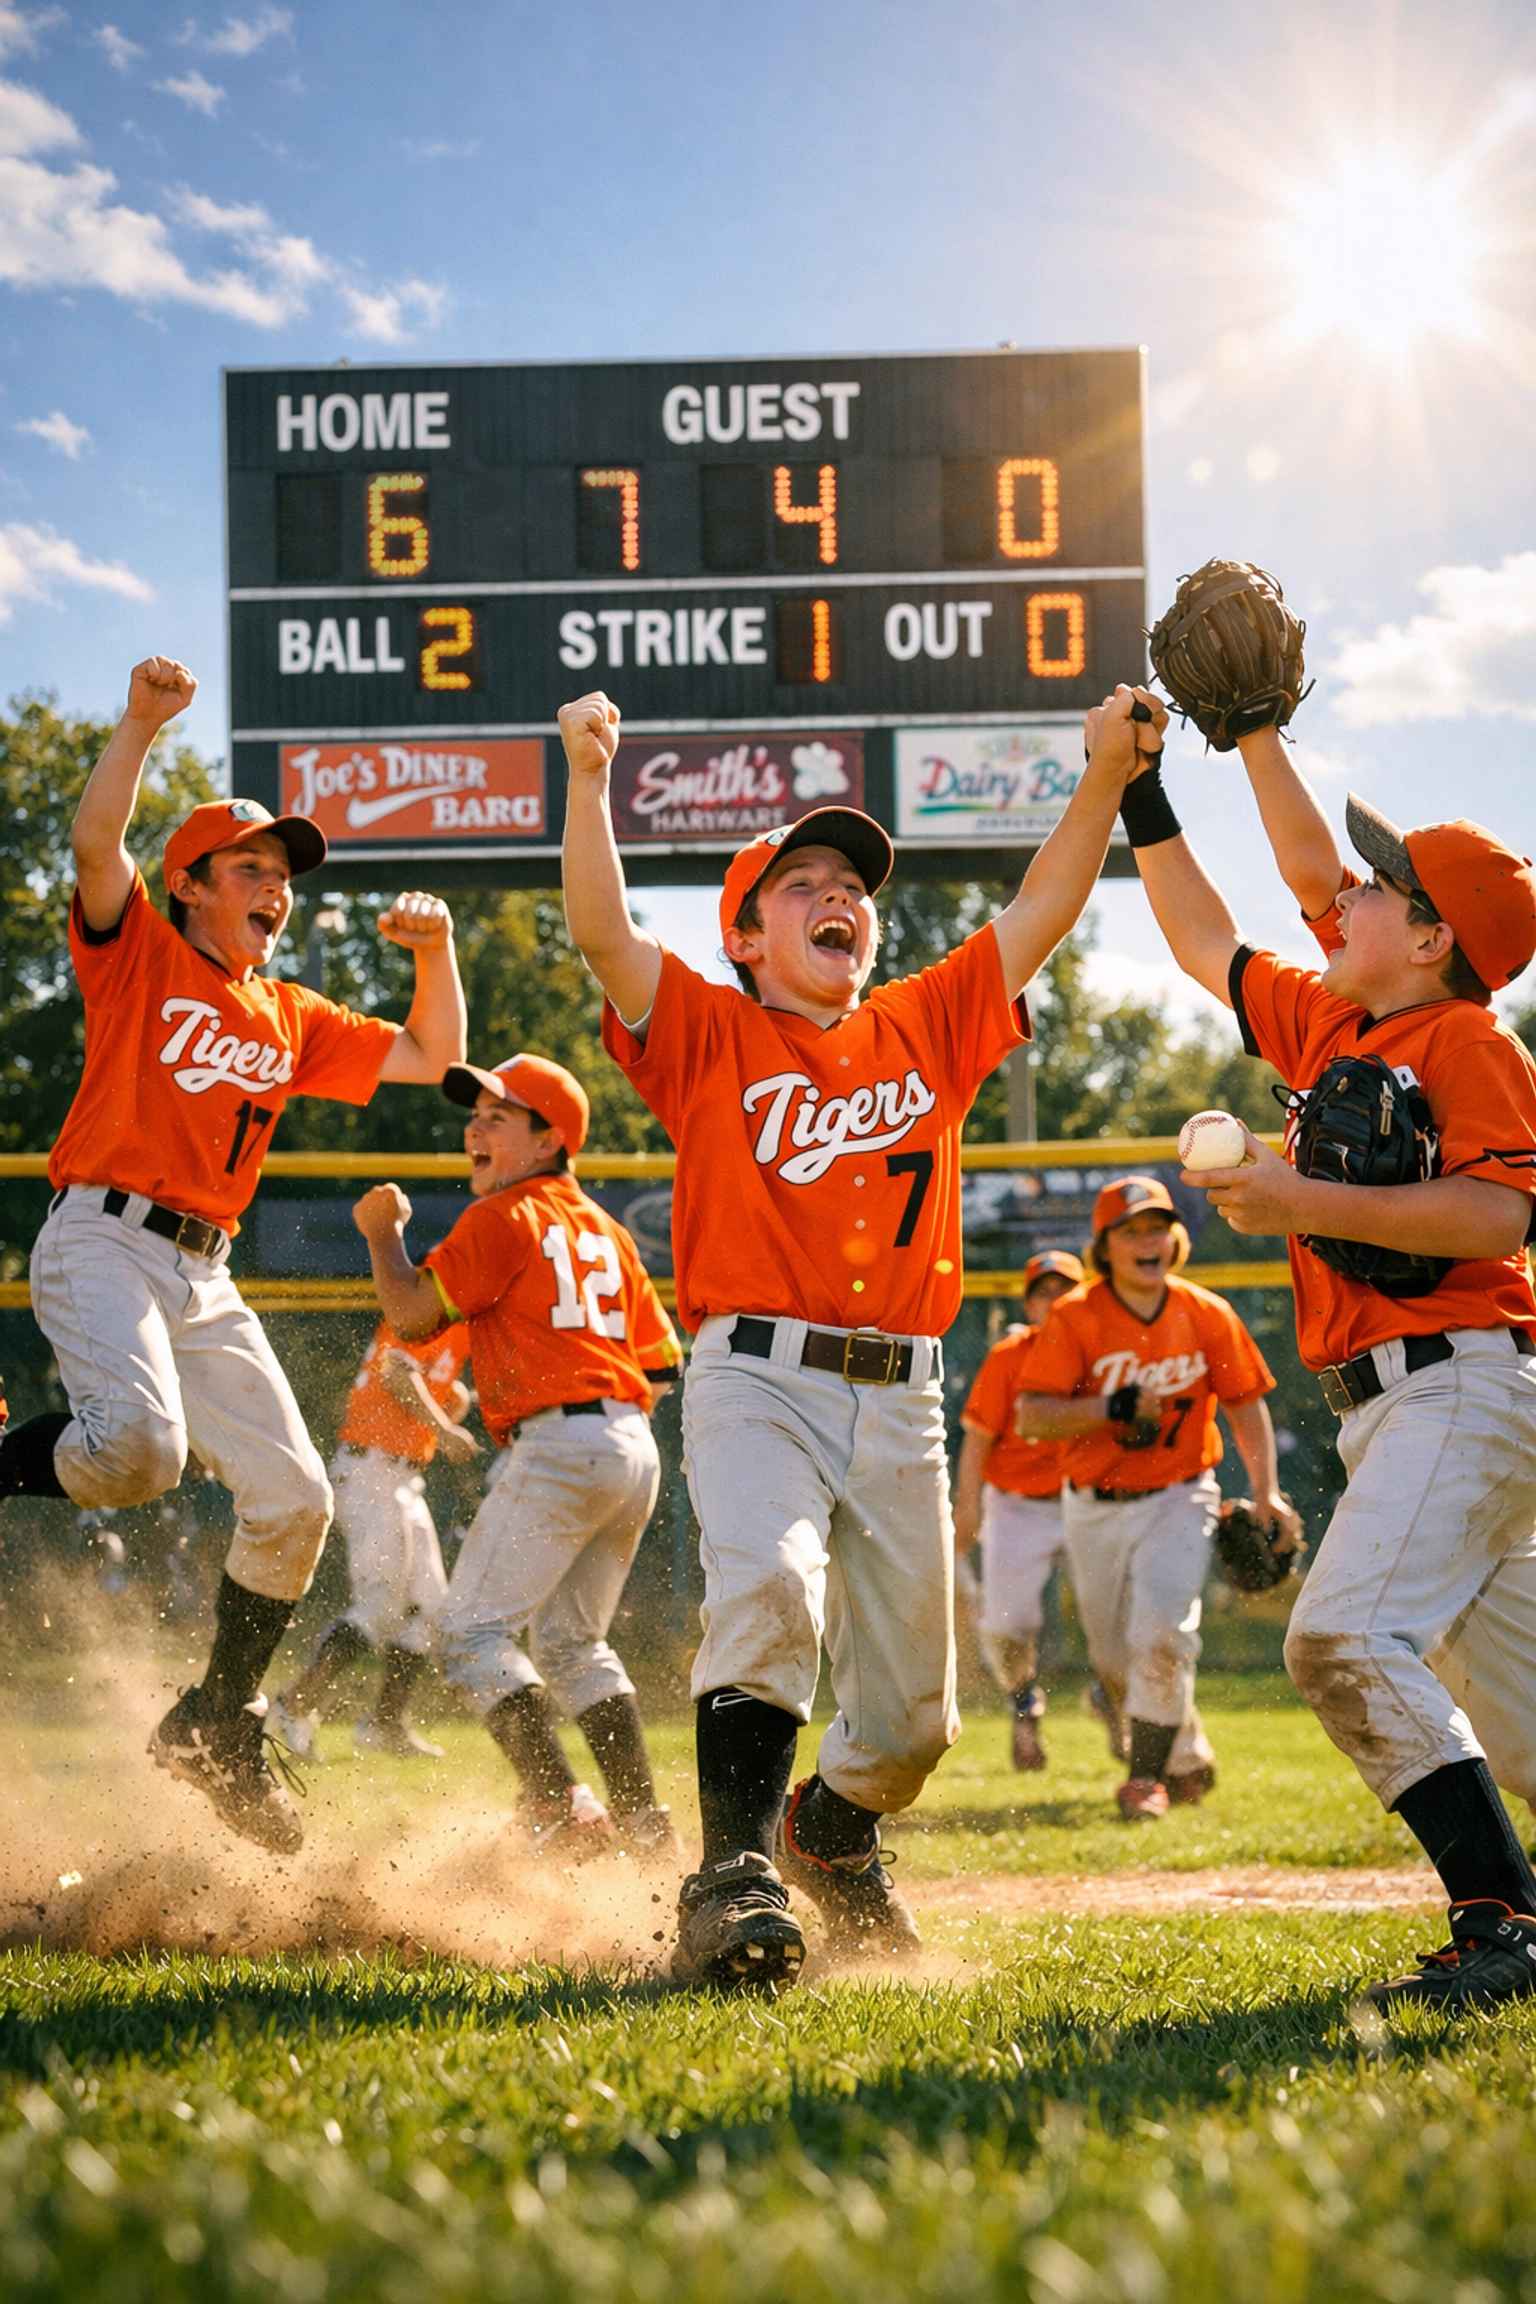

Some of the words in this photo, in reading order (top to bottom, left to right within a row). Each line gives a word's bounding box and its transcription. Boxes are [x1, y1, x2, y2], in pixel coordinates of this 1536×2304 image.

[277, 392, 451, 452] HOME
[662, 382, 861, 444] GUEST
[367, 472, 429, 577] 6
[581, 468, 639, 571] 7
[774, 464, 838, 565] 4
[997, 458, 1059, 559] 0
[278, 616, 405, 675] BALL
[420, 607, 474, 691] 2
[558, 607, 767, 670] STRIKE
[812, 599, 831, 682] 1
[884, 601, 993, 661] OUT
[1027, 593, 1085, 678] 0
[630, 744, 786, 816] Smith's
[919, 756, 1021, 812] Dairy
[1029, 758, 1083, 803] Ba
[158, 997, 294, 1094] Tigers
[224, 1099, 274, 1177] 17
[742, 1068, 936, 1185] Tigers
[886, 1150, 934, 1248] 7
[541, 1224, 627, 1342] 12
